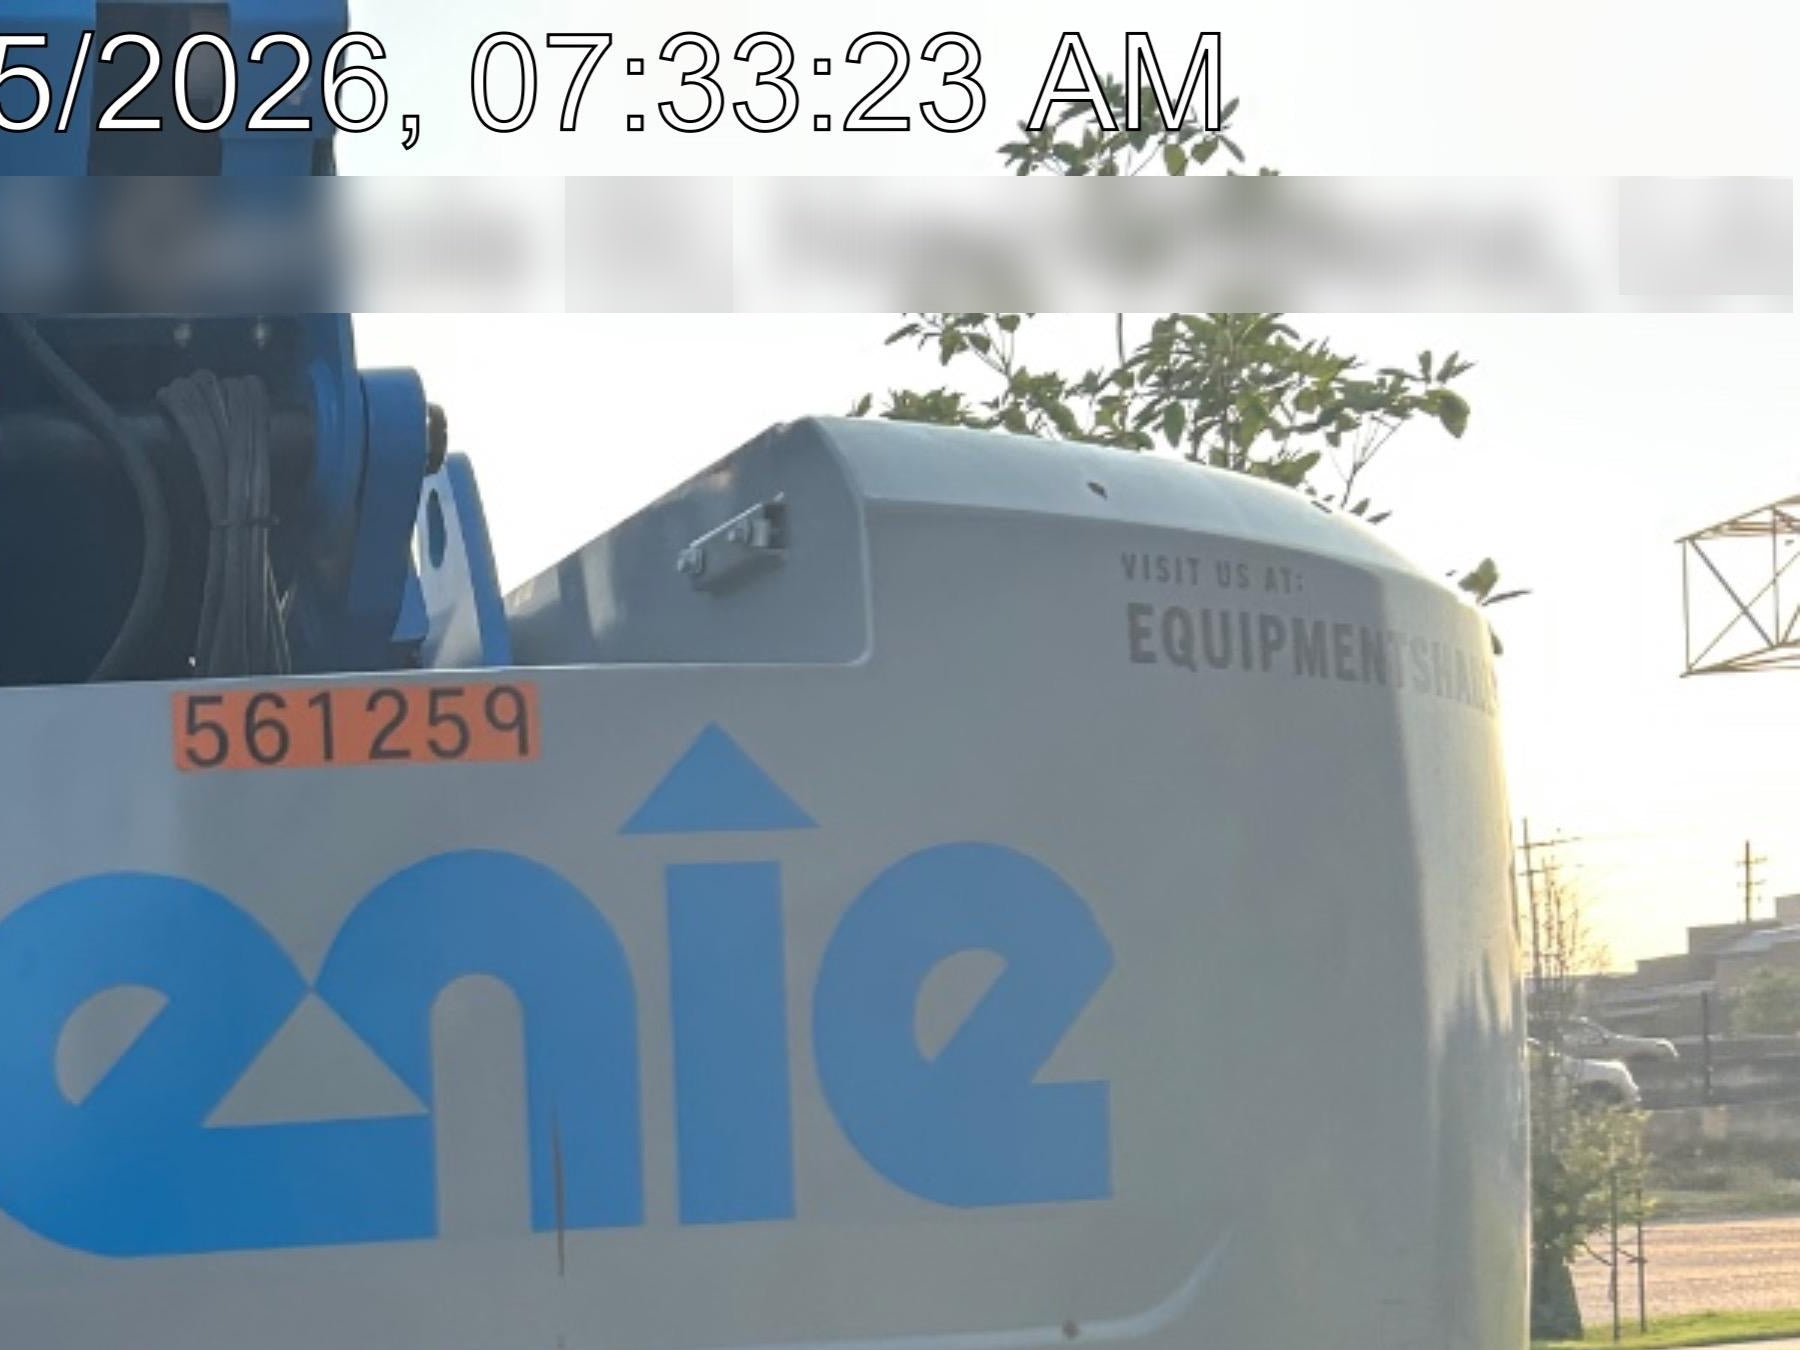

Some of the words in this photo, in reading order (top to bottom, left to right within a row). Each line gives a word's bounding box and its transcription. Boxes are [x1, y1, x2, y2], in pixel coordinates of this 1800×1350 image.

[1121, 552, 1200, 586] VISIT
[1216, 561, 1251, 589] US
[184, 684, 530, 769] 561259
